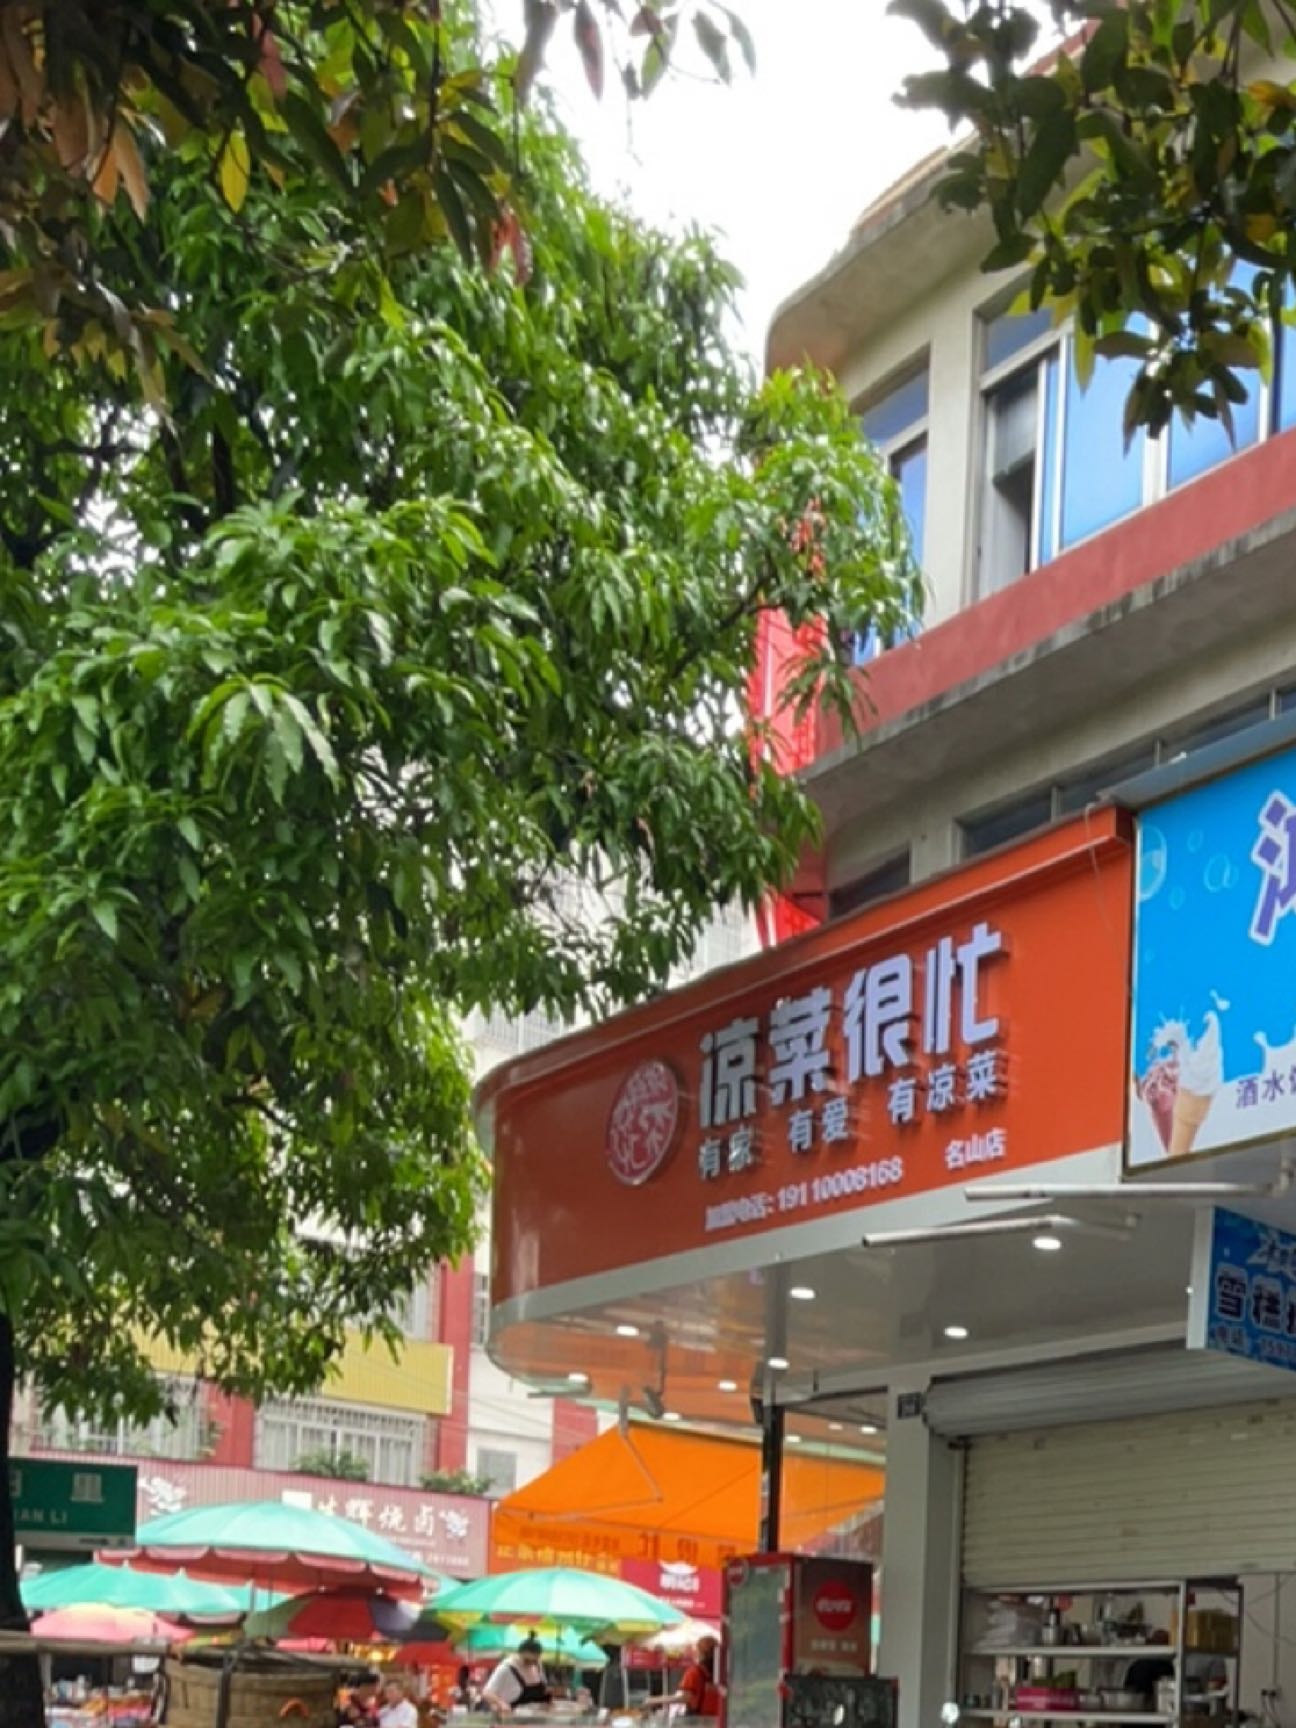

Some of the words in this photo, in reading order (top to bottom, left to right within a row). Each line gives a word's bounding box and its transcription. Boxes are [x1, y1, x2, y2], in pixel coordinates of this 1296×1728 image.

[699, 922, 1001, 1129] 凉菜很忙
[788, 1096, 849, 1153] 有爱
[887, 1050, 999, 1124] 有凉菜
[945, 1127, 1007, 1169] 名山店
